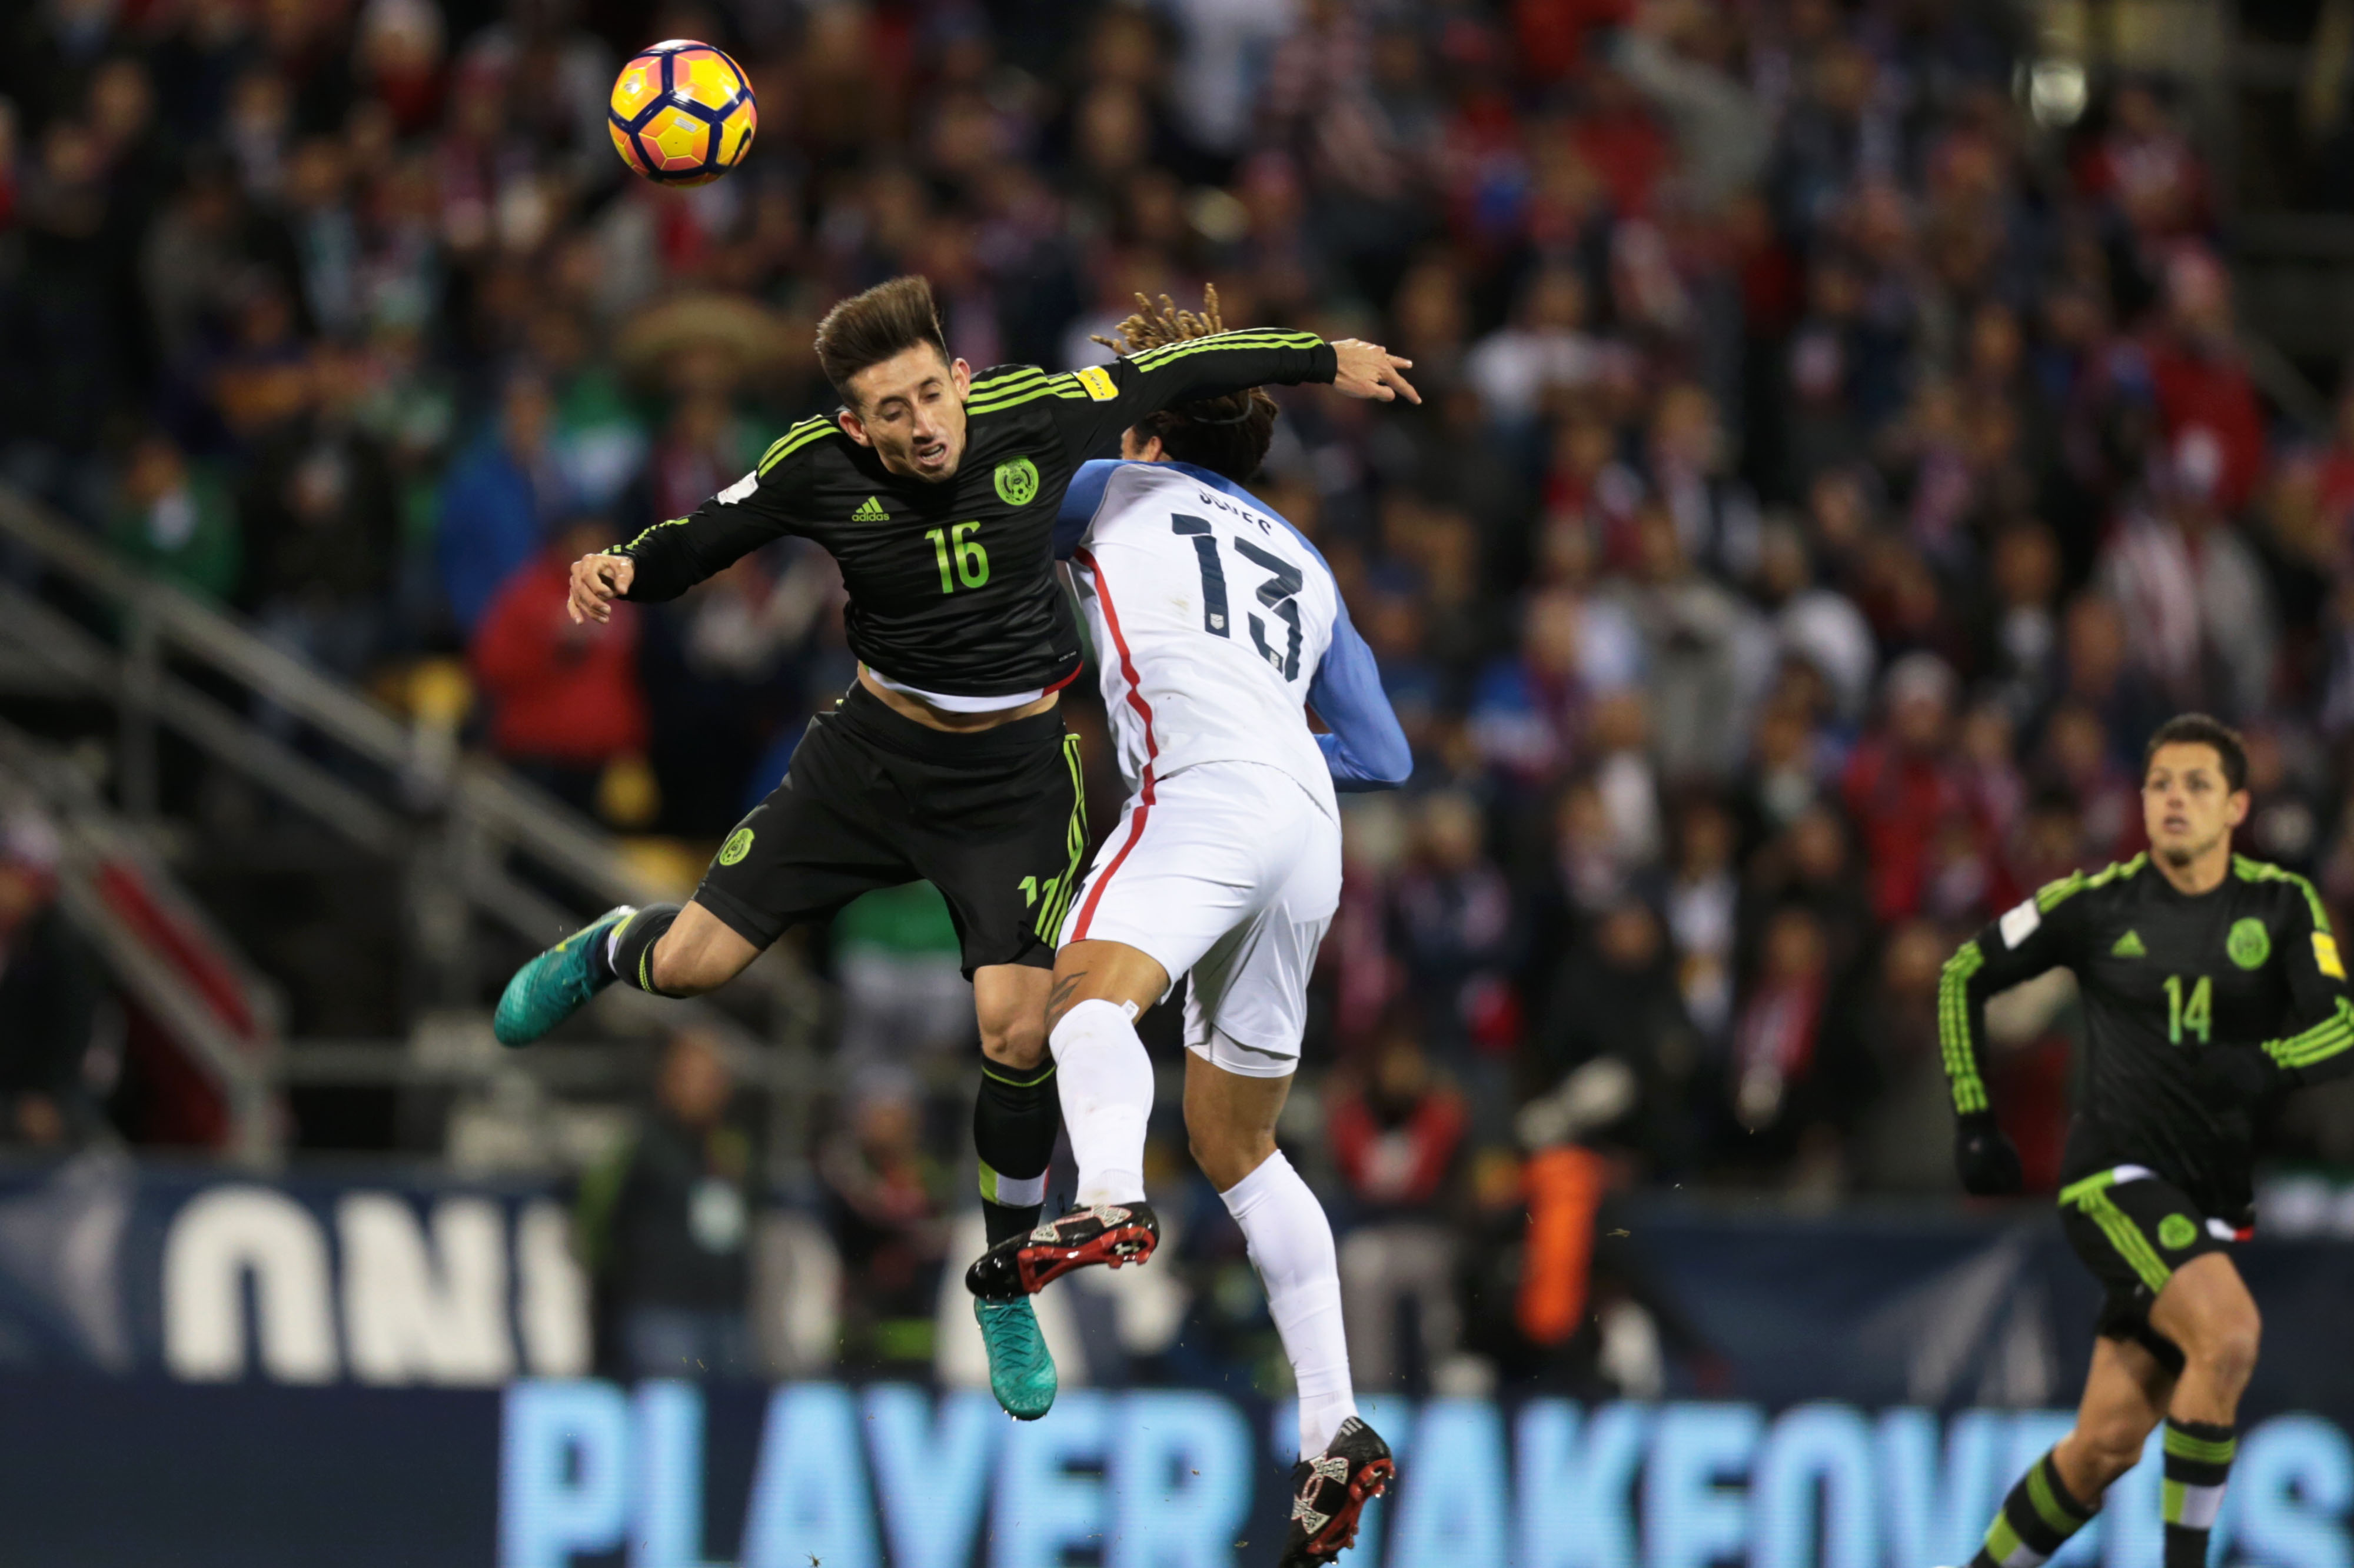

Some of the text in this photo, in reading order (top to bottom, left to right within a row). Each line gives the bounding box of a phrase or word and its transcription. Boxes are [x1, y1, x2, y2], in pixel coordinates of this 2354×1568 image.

[852, 512, 890, 522] adidas
[925, 521, 990, 594] 16
[1171, 512, 1303, 683] 13
[2162, 974, 2212, 1046] 14
[496, 1374, 1258, 1568] PLAYER
